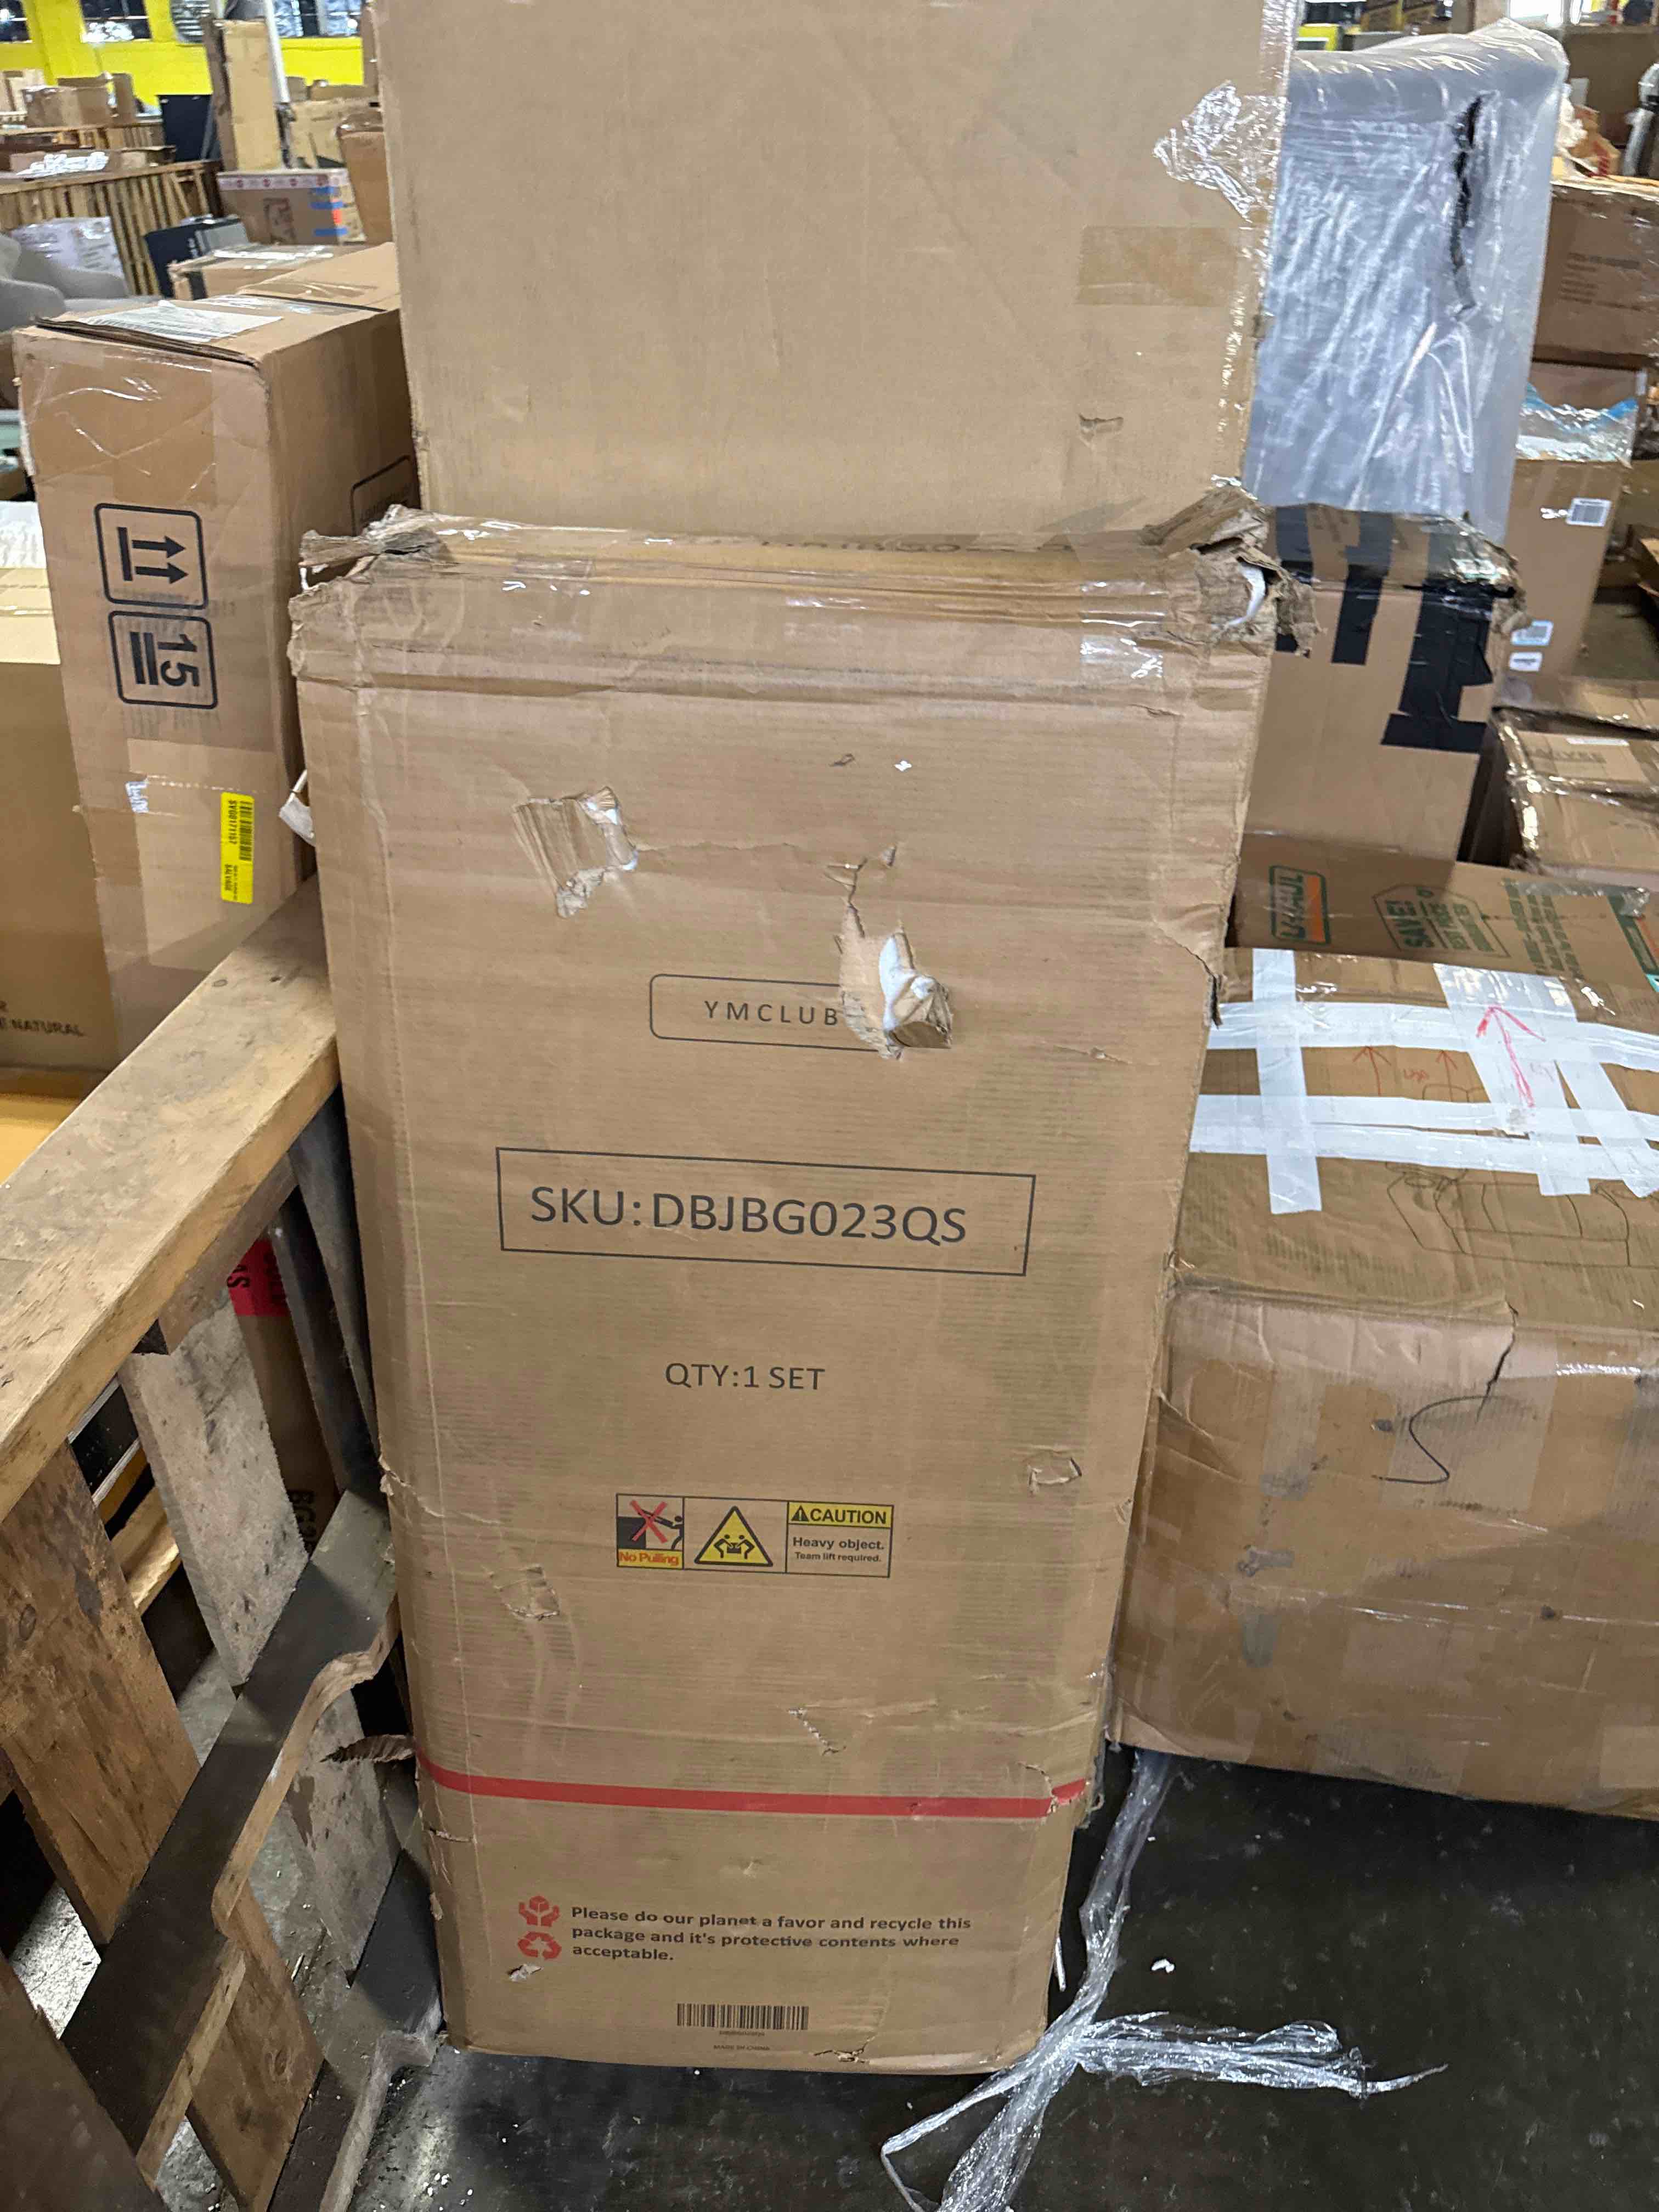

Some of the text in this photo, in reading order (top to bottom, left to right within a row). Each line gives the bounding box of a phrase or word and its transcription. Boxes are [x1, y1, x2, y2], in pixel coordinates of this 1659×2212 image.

[157, 633, 200, 687] 15
[704, 1000, 838, 1026] YMCLUB
[769, 1366, 826, 1390] SET
[810, 1508, 887, 1525] CAUTION
[793, 1537, 884, 1551] Heavy object.
[618, 1551, 680, 1567] No Pulling
[794, 1551, 882, 1562] Team lift required.
[571, 1906, 972, 1932] Please do our planet a favor and recycle this
[572, 1926, 960, 1948] package and it's protective contents where
[573, 1945, 674, 1961] acceptable.
